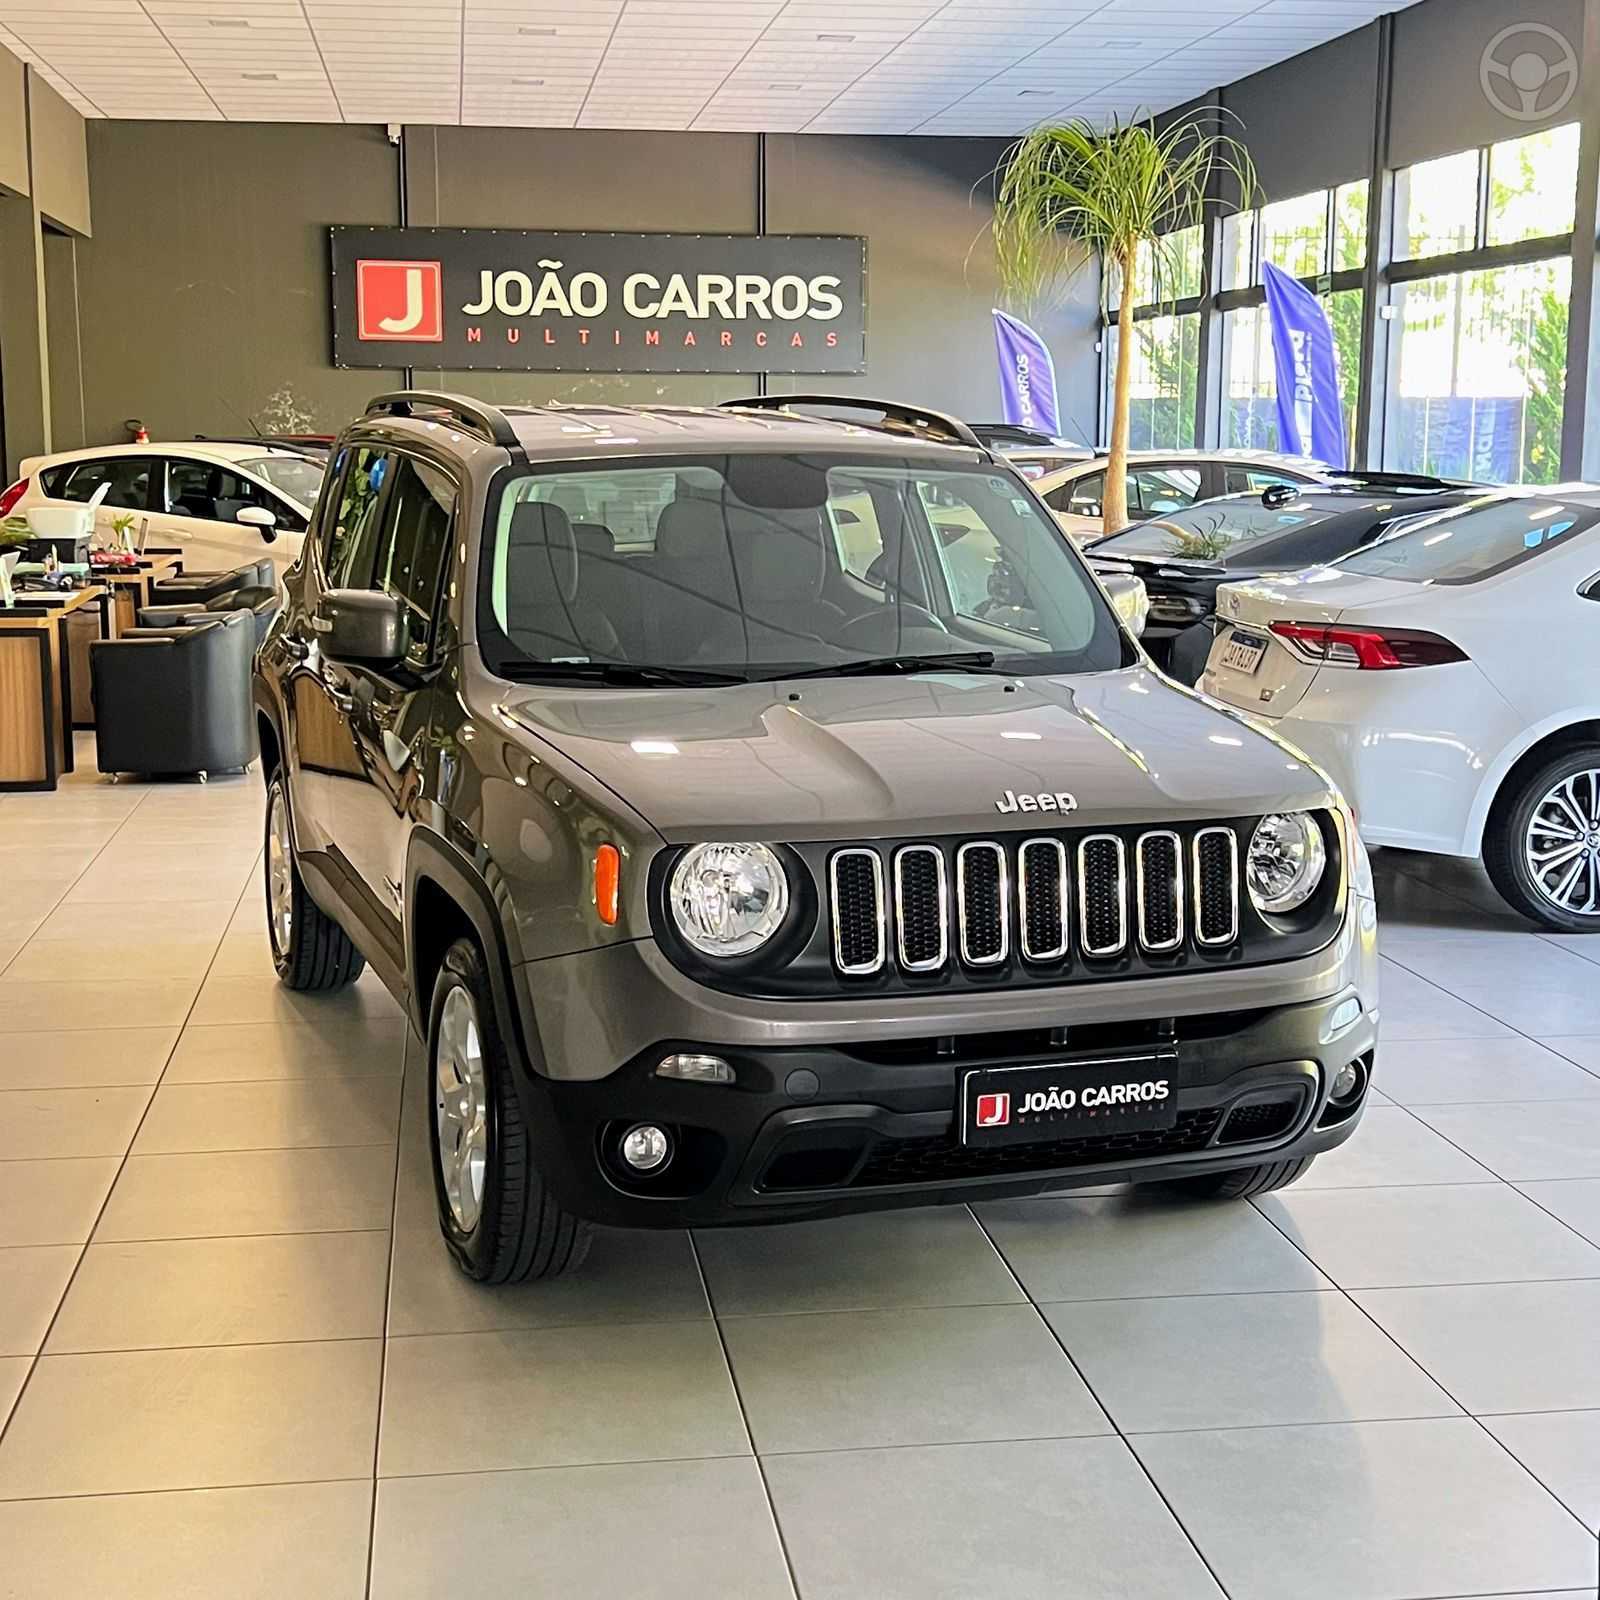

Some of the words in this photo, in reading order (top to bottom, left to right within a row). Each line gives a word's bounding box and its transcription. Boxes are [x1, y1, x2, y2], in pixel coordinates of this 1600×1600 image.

[378, 268, 423, 333] J
[462, 259, 608, 318] JOÃO
[623, 273, 843, 320] CARROS
[467, 326, 838, 347] MULTIMARCAS
[1016, 353, 1032, 415] CARROS
[994, 789, 1078, 816] Jeep
[983, 1095, 1003, 1123] J
[1017, 1086, 1077, 1114] JOÃO
[1081, 1080, 1169, 1107] CARROS
